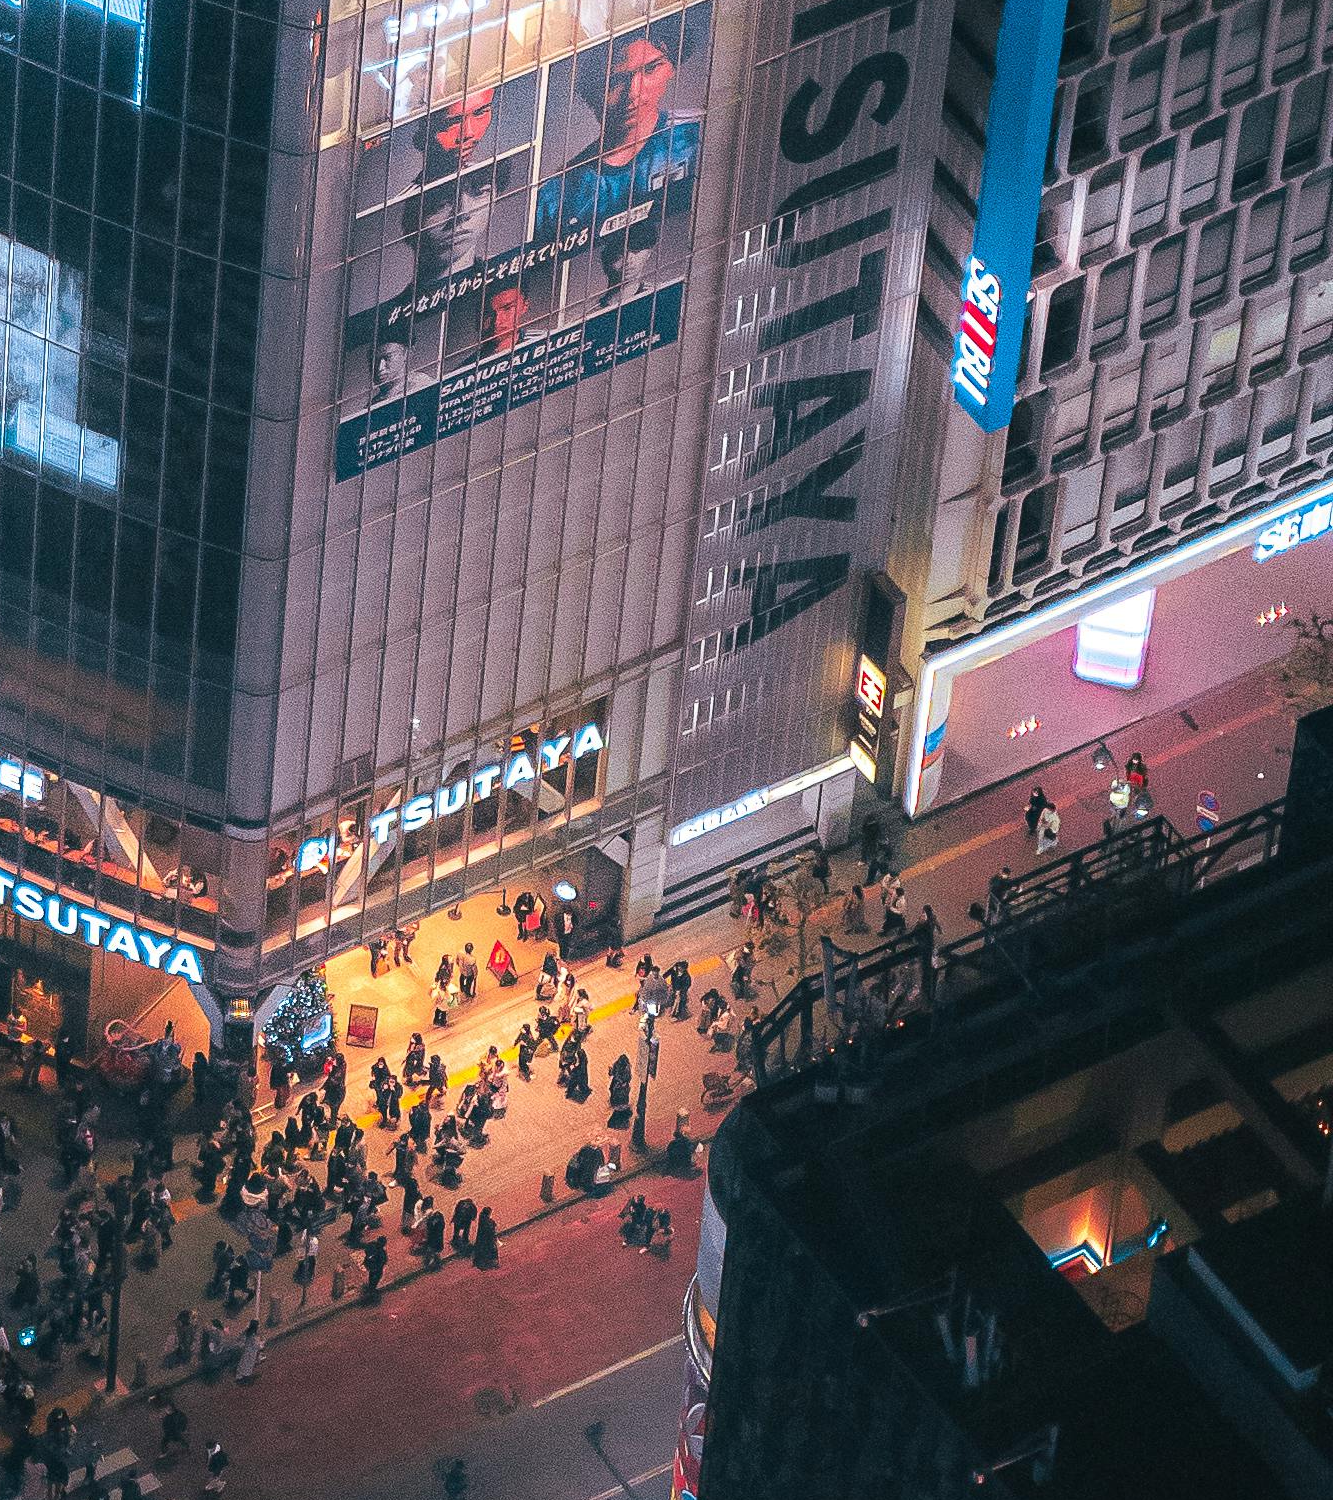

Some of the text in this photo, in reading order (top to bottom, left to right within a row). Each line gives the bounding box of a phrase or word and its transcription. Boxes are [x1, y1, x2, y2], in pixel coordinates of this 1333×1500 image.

[438, 328, 585, 398] SAMURAI BLUE
[957, 256, 1001, 406] SEIBU
[368, 719, 606, 844] TSUTAYA
